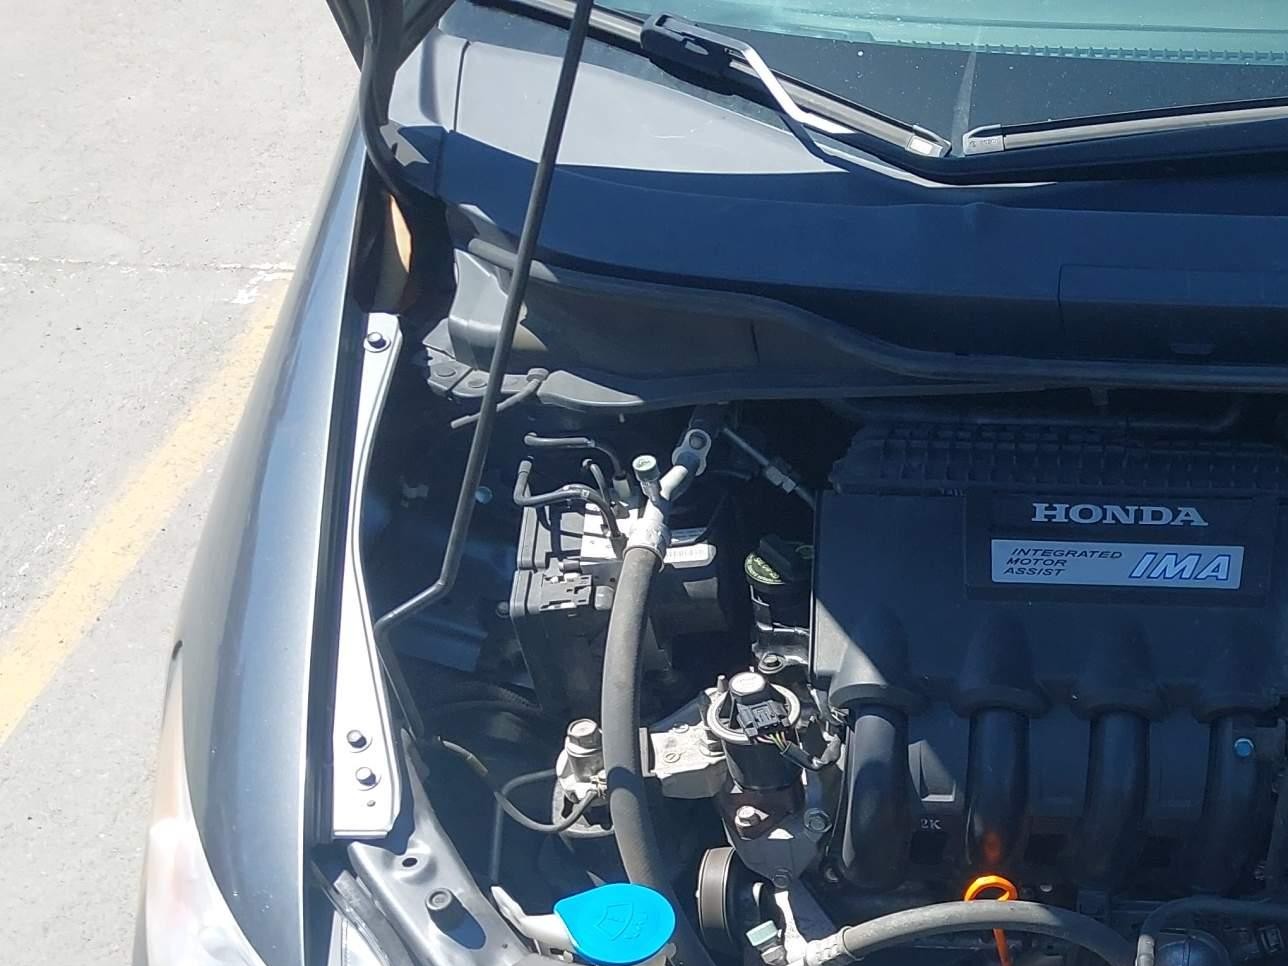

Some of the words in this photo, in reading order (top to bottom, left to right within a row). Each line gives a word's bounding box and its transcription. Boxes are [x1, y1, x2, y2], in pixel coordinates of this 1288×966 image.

[1032, 503, 1209, 526] HONDA
[1010, 548, 1123, 560] INTEGRATED
[1005, 557, 1068, 568] MOTOR
[1128, 551, 1232, 582] IMA
[1002, 567, 1066, 578] ASSIST
